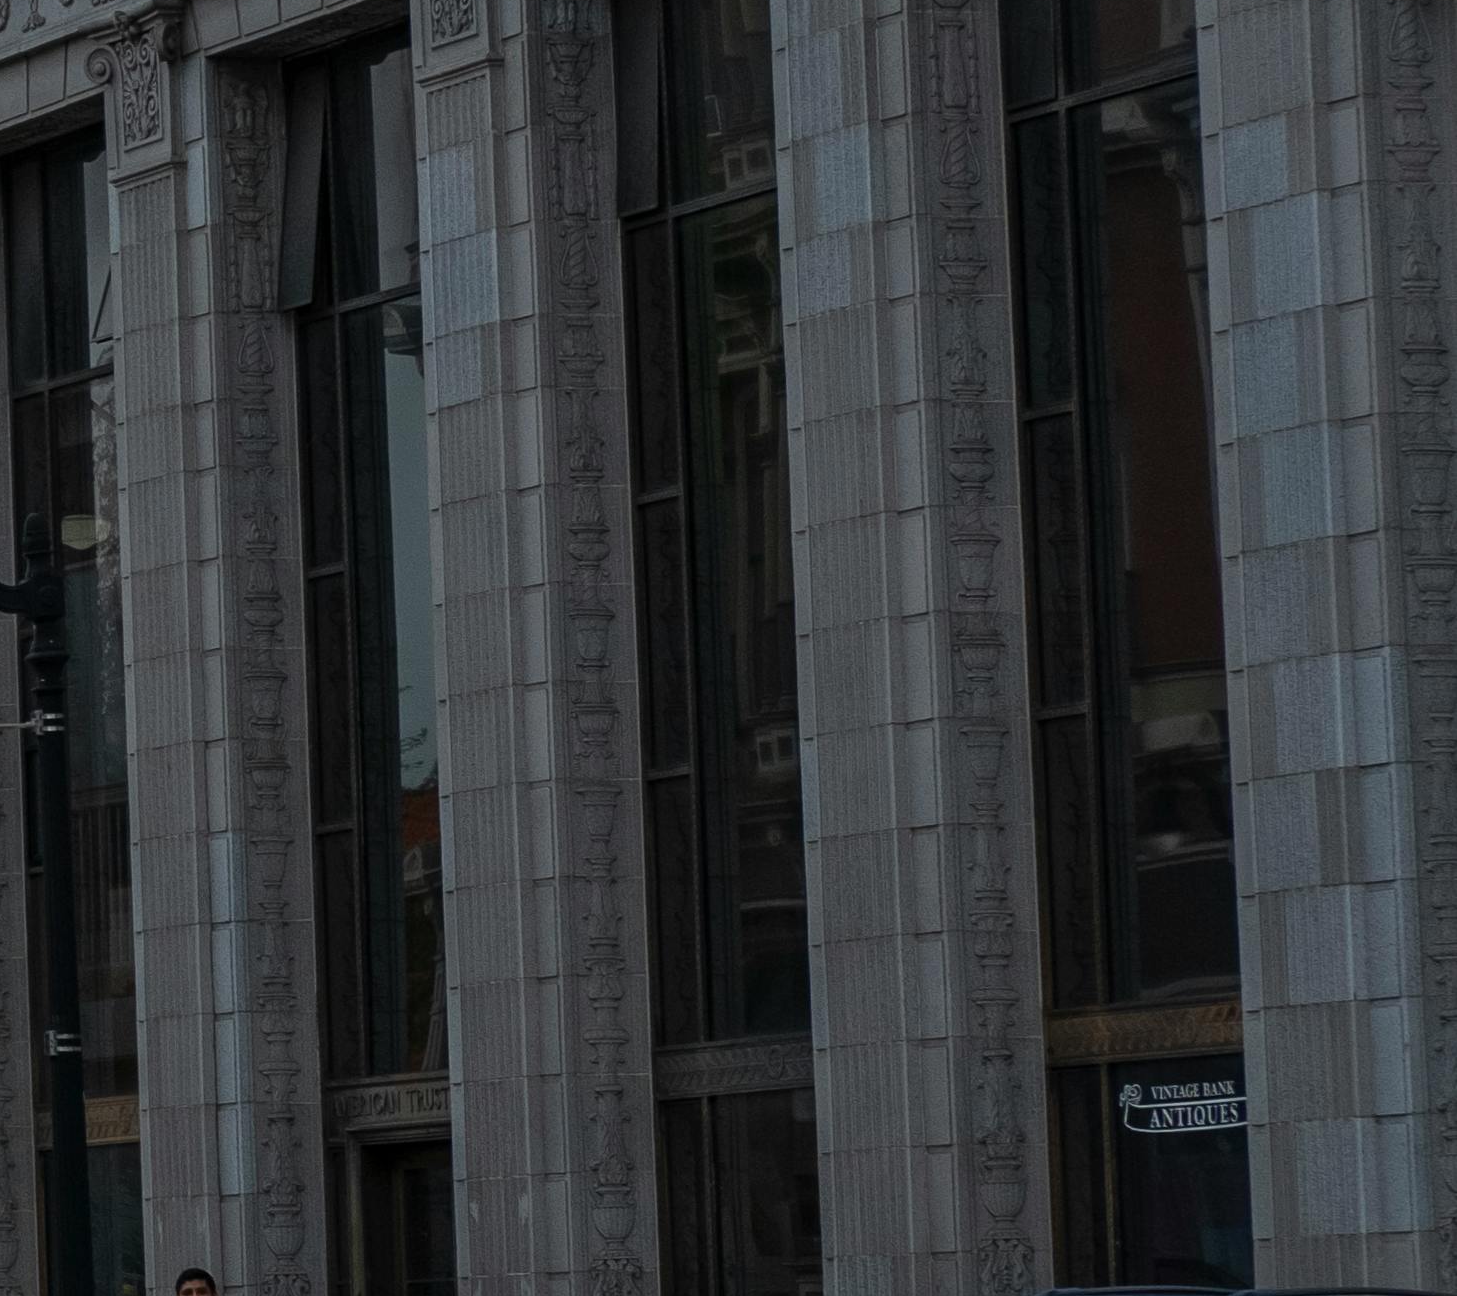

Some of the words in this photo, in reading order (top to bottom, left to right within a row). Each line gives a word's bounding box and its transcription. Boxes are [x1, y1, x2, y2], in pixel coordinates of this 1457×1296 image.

[1150, 1083, 1201, 1100] VINTAGE
[1202, 1080, 1236, 1097] BANK
[1149, 1103, 1239, 1128] ANTIQUES
